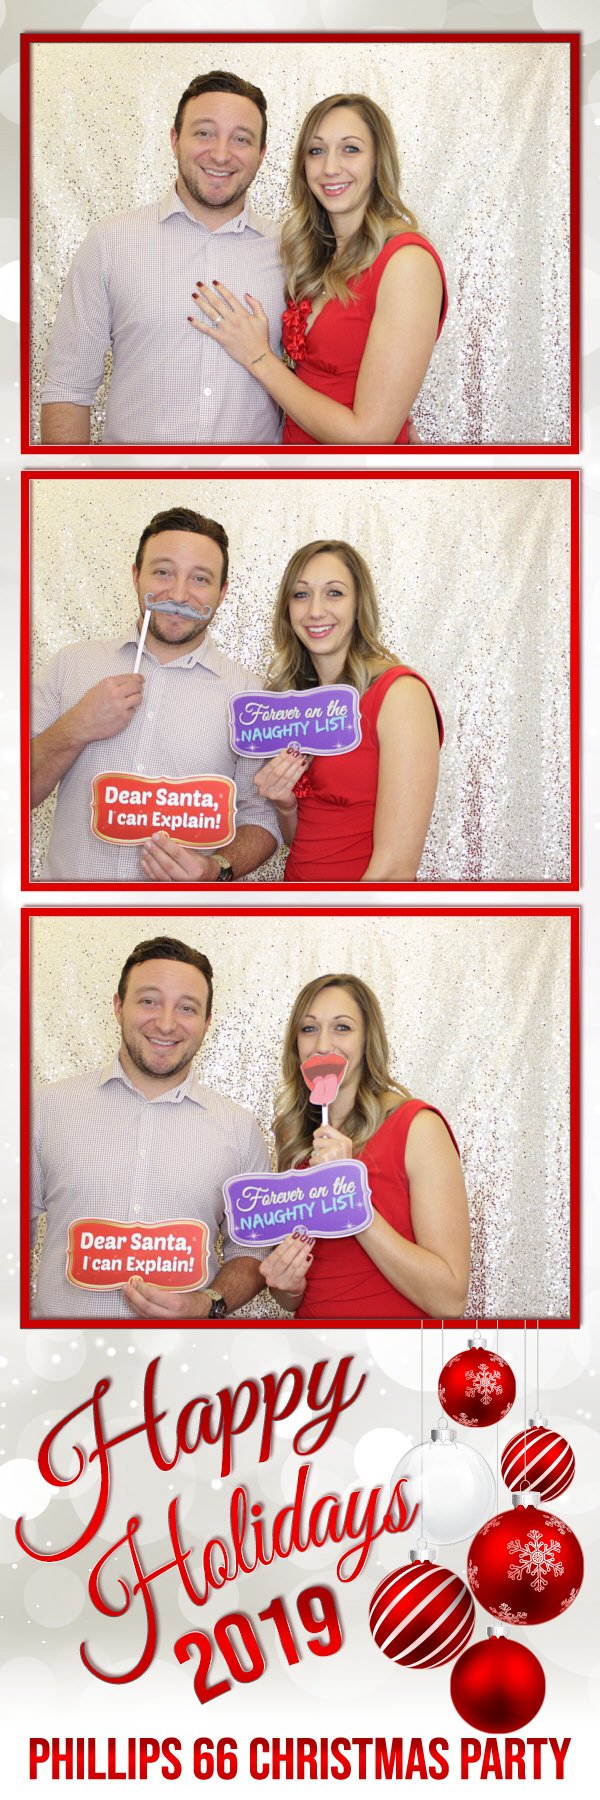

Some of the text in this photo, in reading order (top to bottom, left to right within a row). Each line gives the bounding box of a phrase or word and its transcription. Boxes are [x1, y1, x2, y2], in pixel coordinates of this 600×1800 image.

[239, 699, 348, 725] Forever on the
[241, 715, 348, 742] NAUGHTY LIST
[105, 786, 219, 812] Dear Santa,
[108, 809, 221, 831] I can Explain!
[236, 1175, 356, 1212] Forever on the
[240, 1192, 357, 1230] NAUGHTY LIST
[80, 1232, 192, 1255] Dear Santa,
[82, 1255, 195, 1275] I can Explain!
